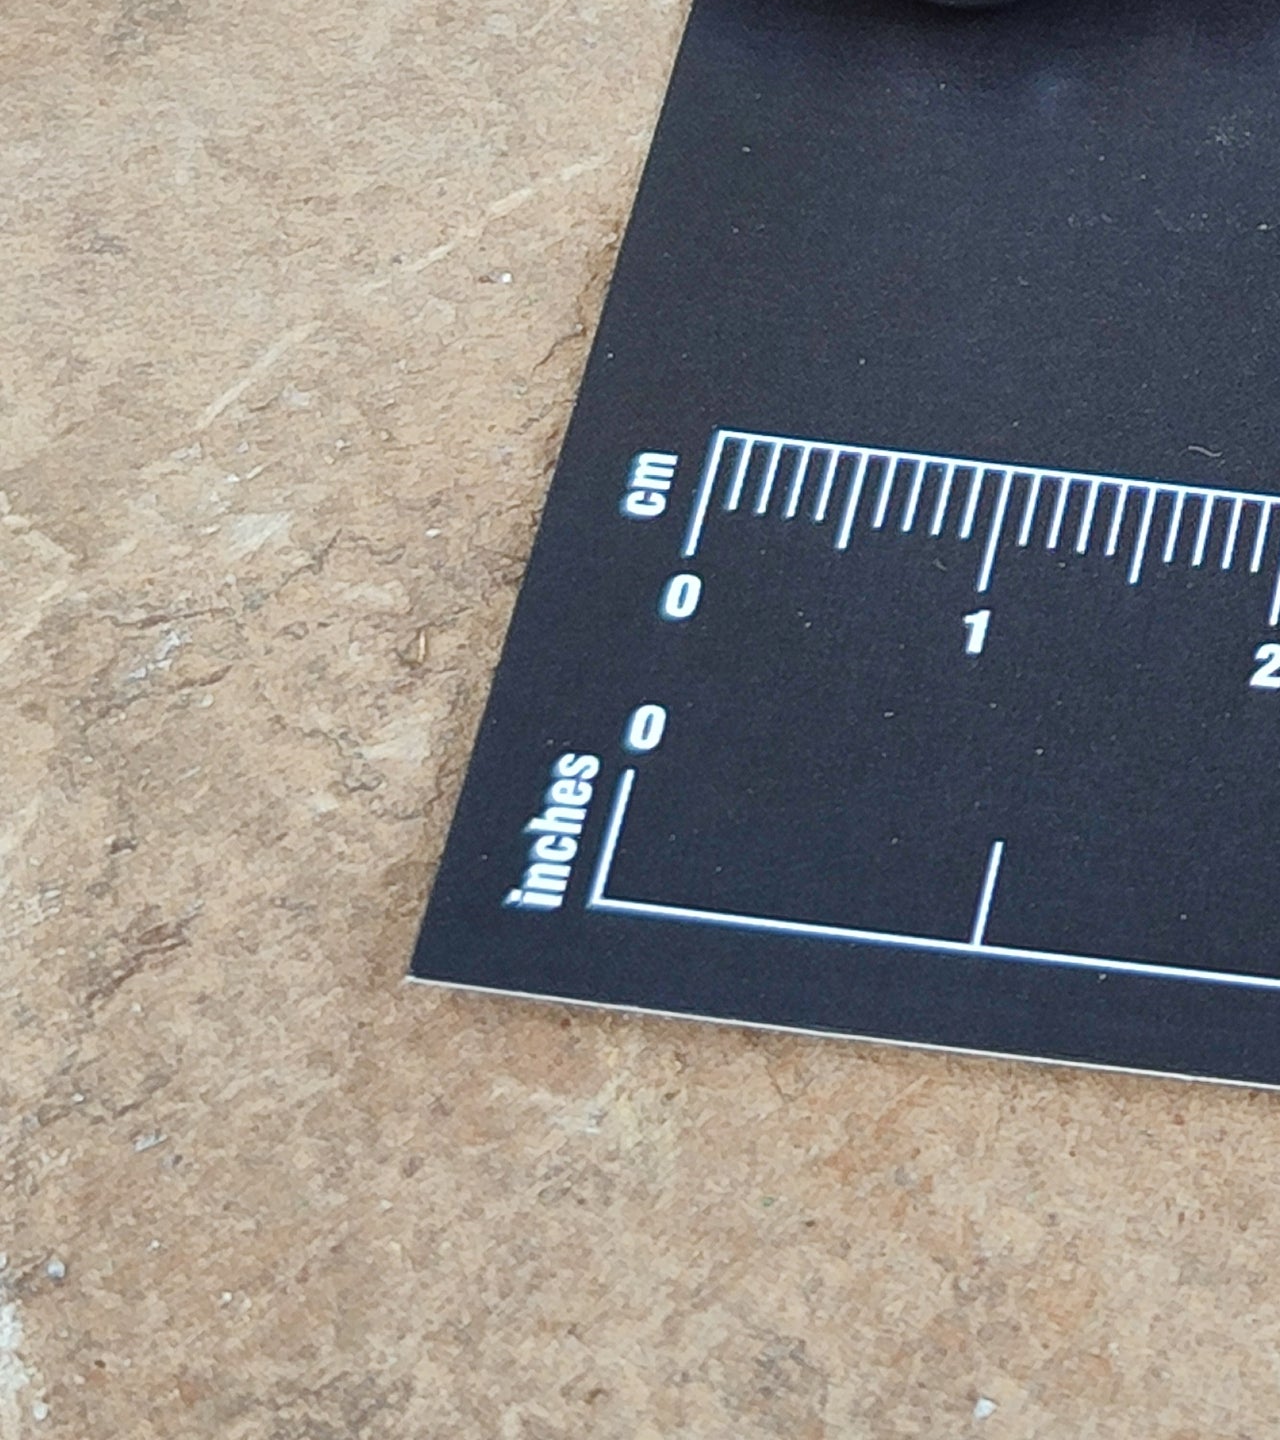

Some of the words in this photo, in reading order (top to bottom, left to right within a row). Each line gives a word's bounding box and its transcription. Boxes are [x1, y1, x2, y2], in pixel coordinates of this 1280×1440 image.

[620, 451, 679, 519] cm
[660, 572, 703, 620] 0
[962, 608, 992, 656] 1
[624, 703, 668, 752] 0
[503, 752, 601, 910] inches
